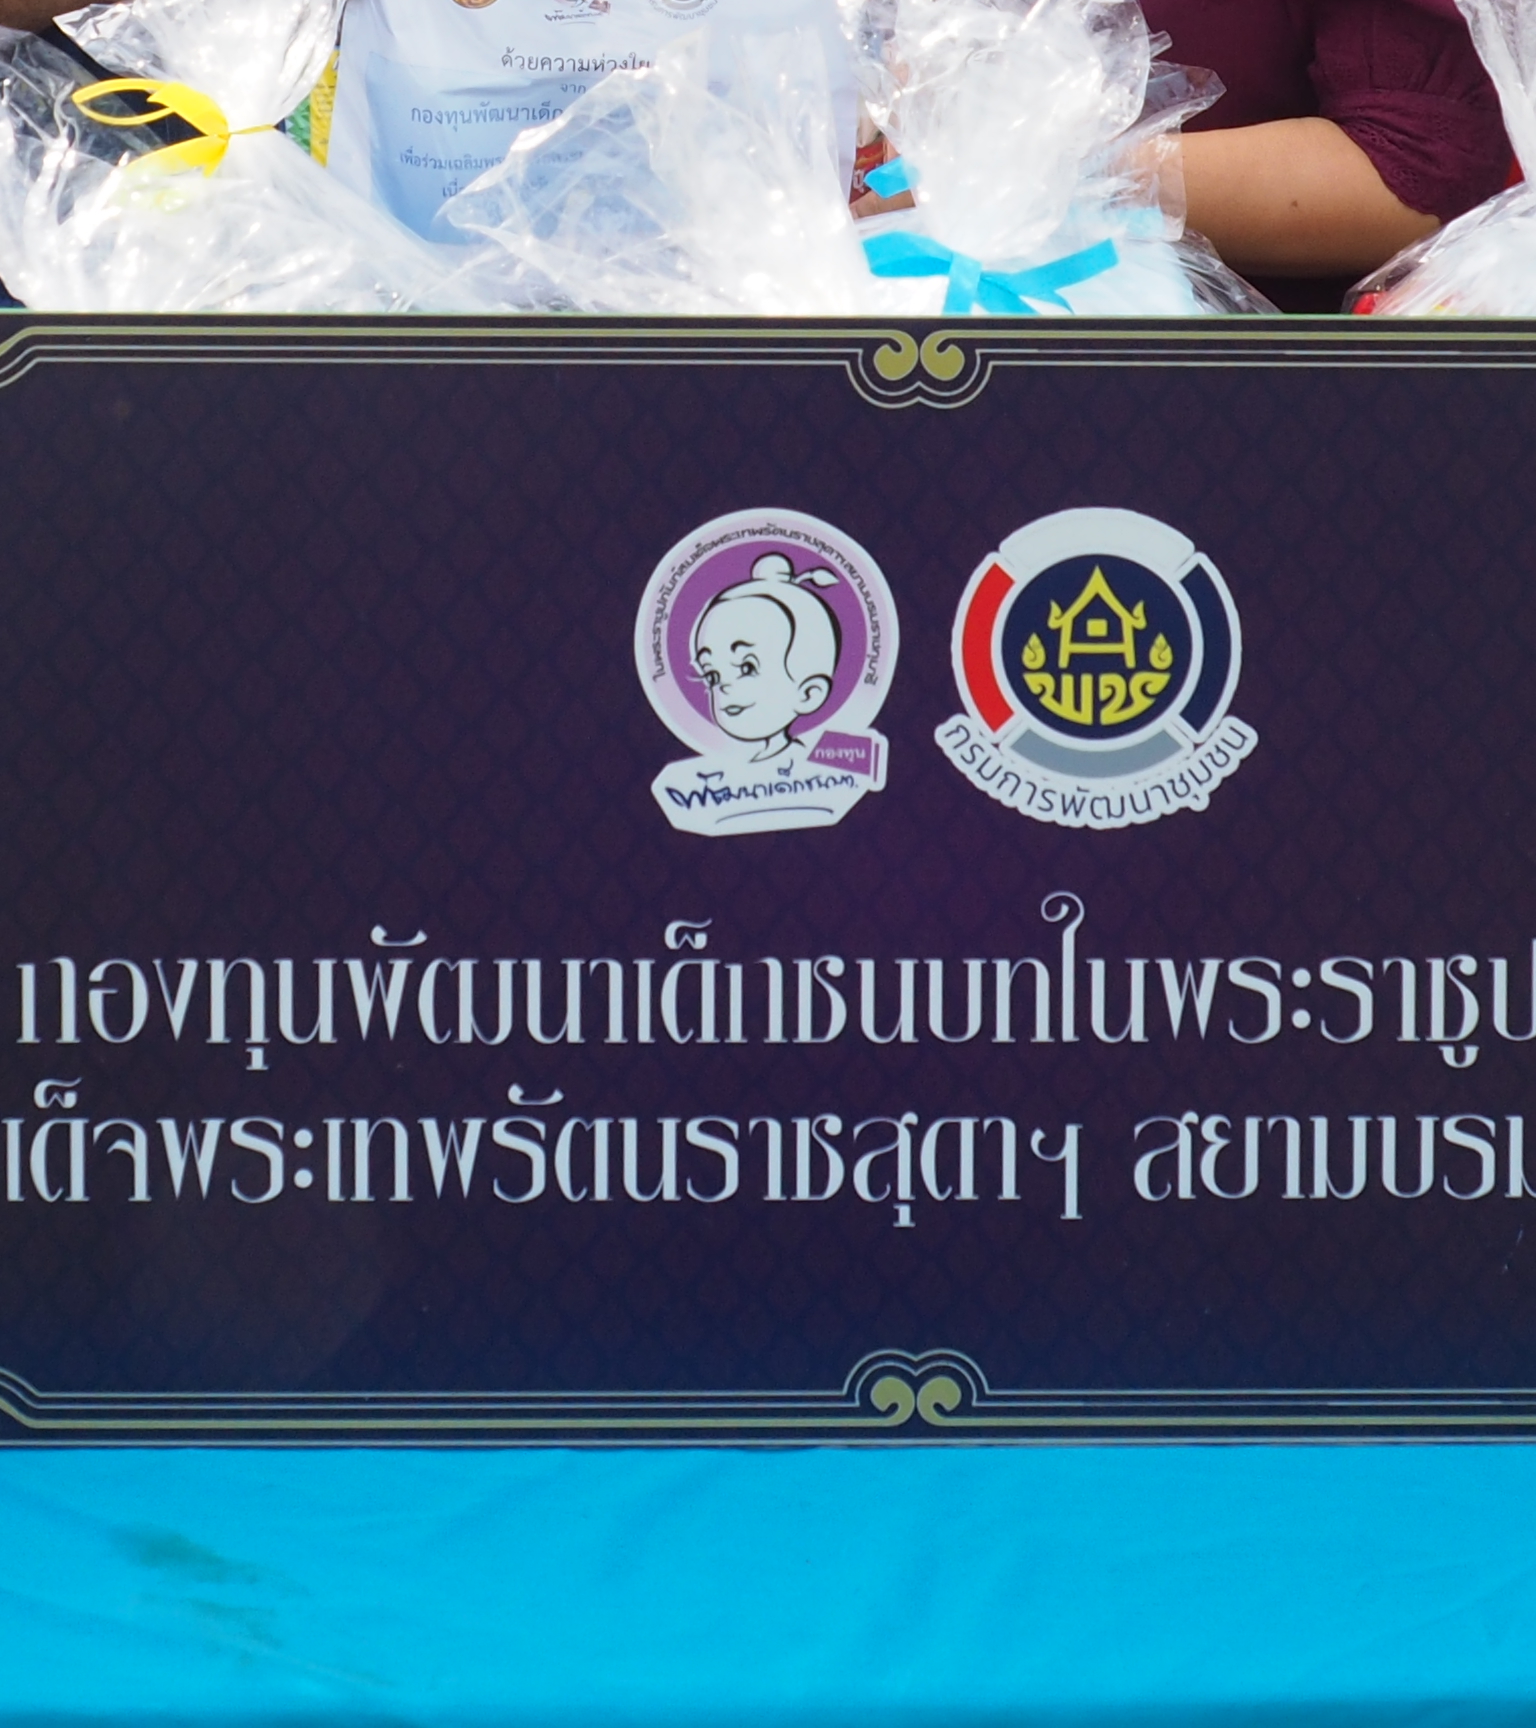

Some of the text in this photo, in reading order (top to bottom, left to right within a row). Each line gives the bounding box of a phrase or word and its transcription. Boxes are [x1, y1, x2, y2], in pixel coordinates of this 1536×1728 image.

[814, 746, 868, 764] กองทุน
[944, 723, 1250, 821] กรมการพัฒนาชุมชน
